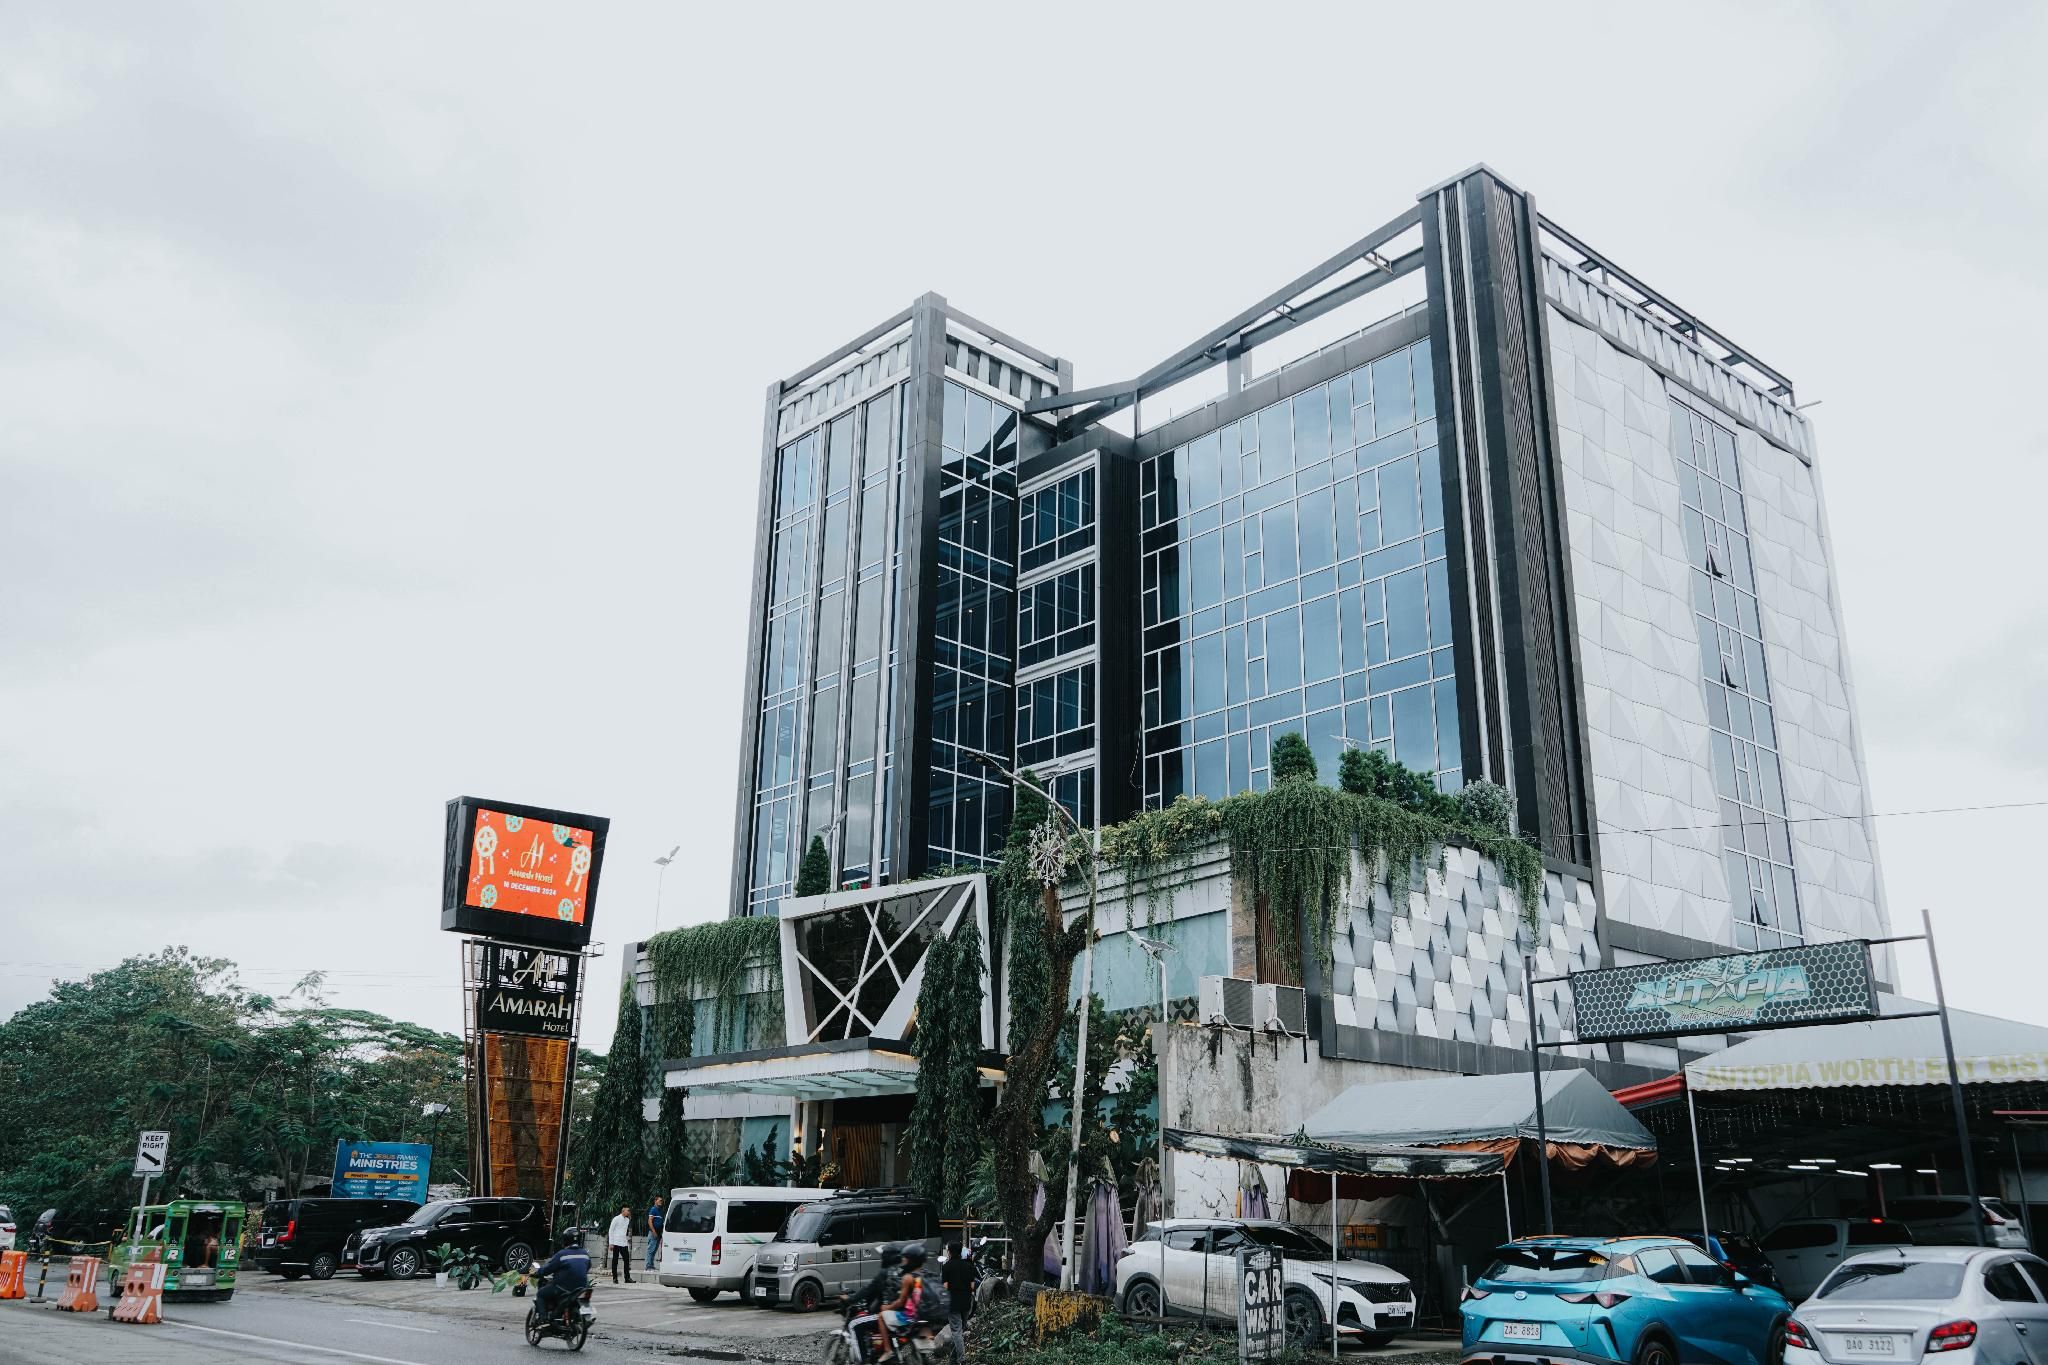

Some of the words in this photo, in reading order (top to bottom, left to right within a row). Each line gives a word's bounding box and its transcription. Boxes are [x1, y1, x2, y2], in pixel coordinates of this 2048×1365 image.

[510, 882, 541, 893] DECEMBER
[488, 991, 572, 1020] AMARAH
[1704, 1062, 1812, 1086] AUTOPIA
[350, 1159, 418, 1170] MINISTRIES
[1244, 1269, 1281, 1305] CAR
[1245, 1305, 1283, 1335] WASH
